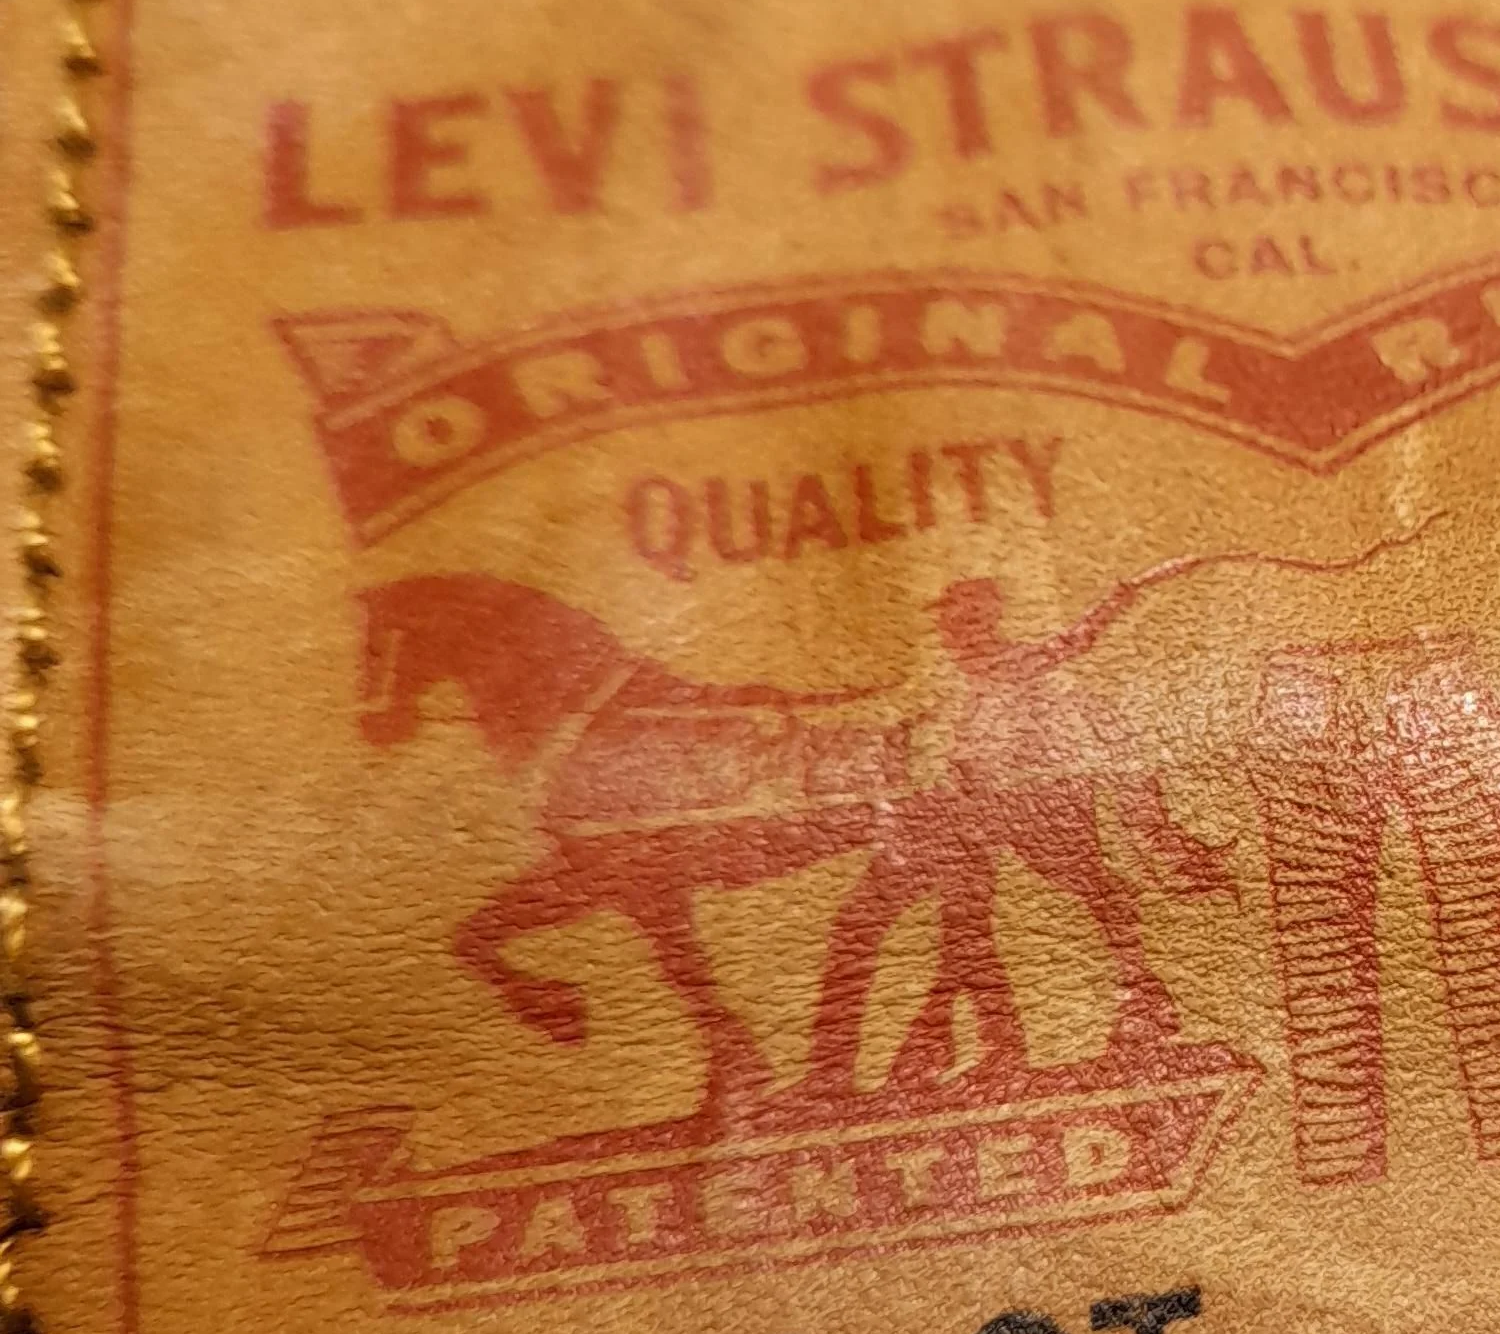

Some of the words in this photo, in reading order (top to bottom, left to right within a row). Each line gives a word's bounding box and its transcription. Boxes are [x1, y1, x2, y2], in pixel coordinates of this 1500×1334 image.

[262, 70, 716, 230] LEVI
[936, 181, 1090, 239] SAN
[388, 300, 1230, 465] ORIGINAL
[622, 435, 1064, 584] QUALITY
[426, 1126, 1132, 1272] PATENTED
